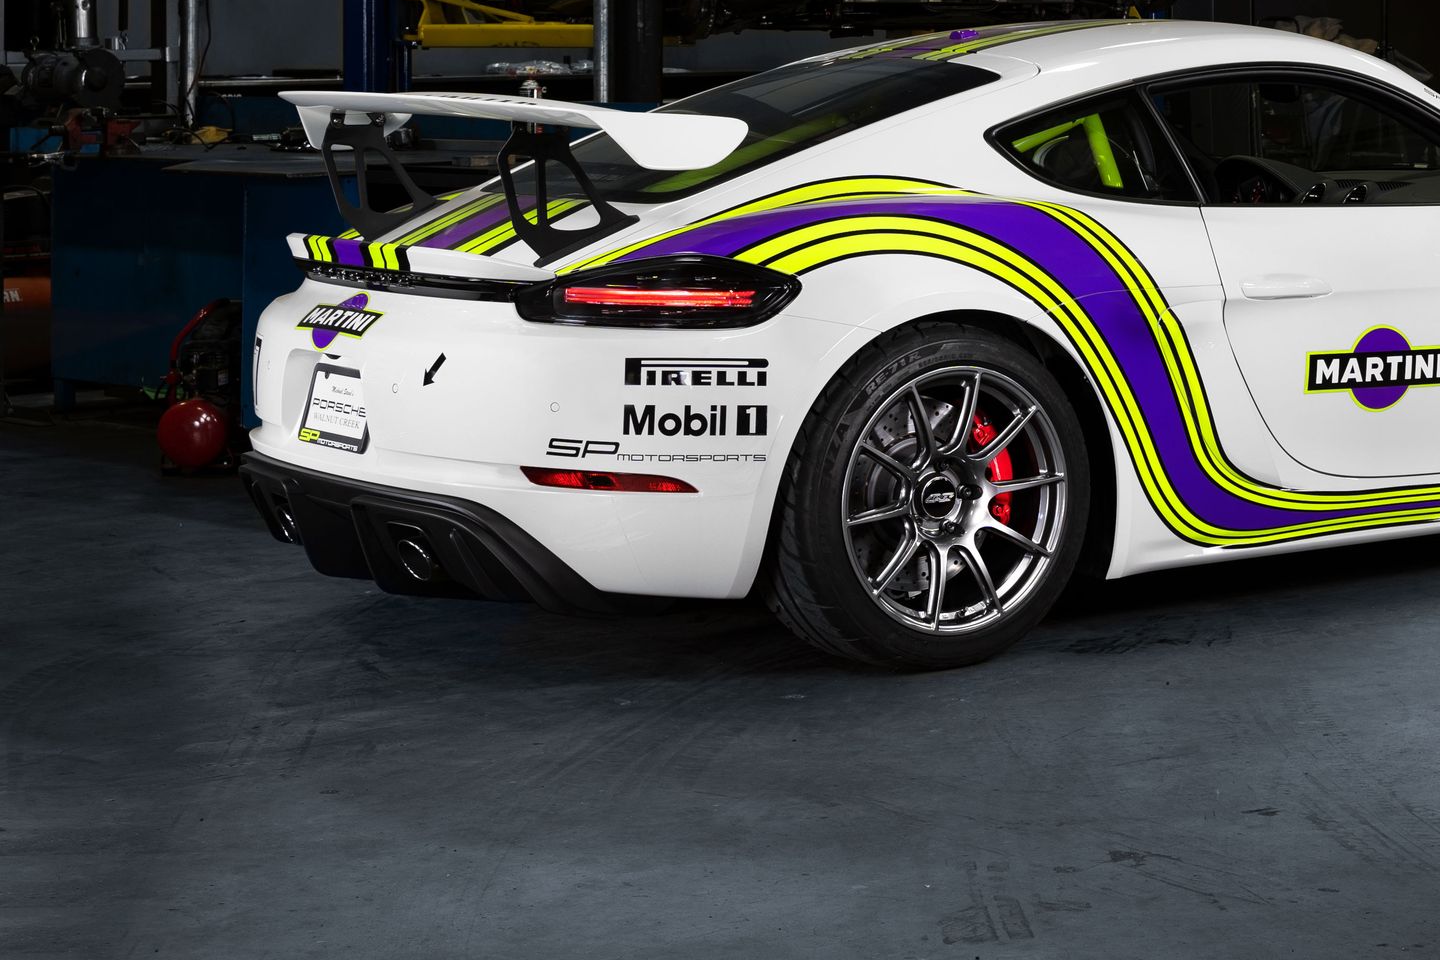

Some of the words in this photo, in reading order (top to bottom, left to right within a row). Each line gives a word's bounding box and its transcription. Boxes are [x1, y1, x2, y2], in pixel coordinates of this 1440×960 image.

[303, 307, 377, 332] MARTINI
[624, 358, 769, 386] PIRELLI
[311, 397, 367, 418] PORSCHE
[623, 405, 727, 436] Mobil
[299, 428, 320, 442] SP
[546, 437, 620, 458] SP
